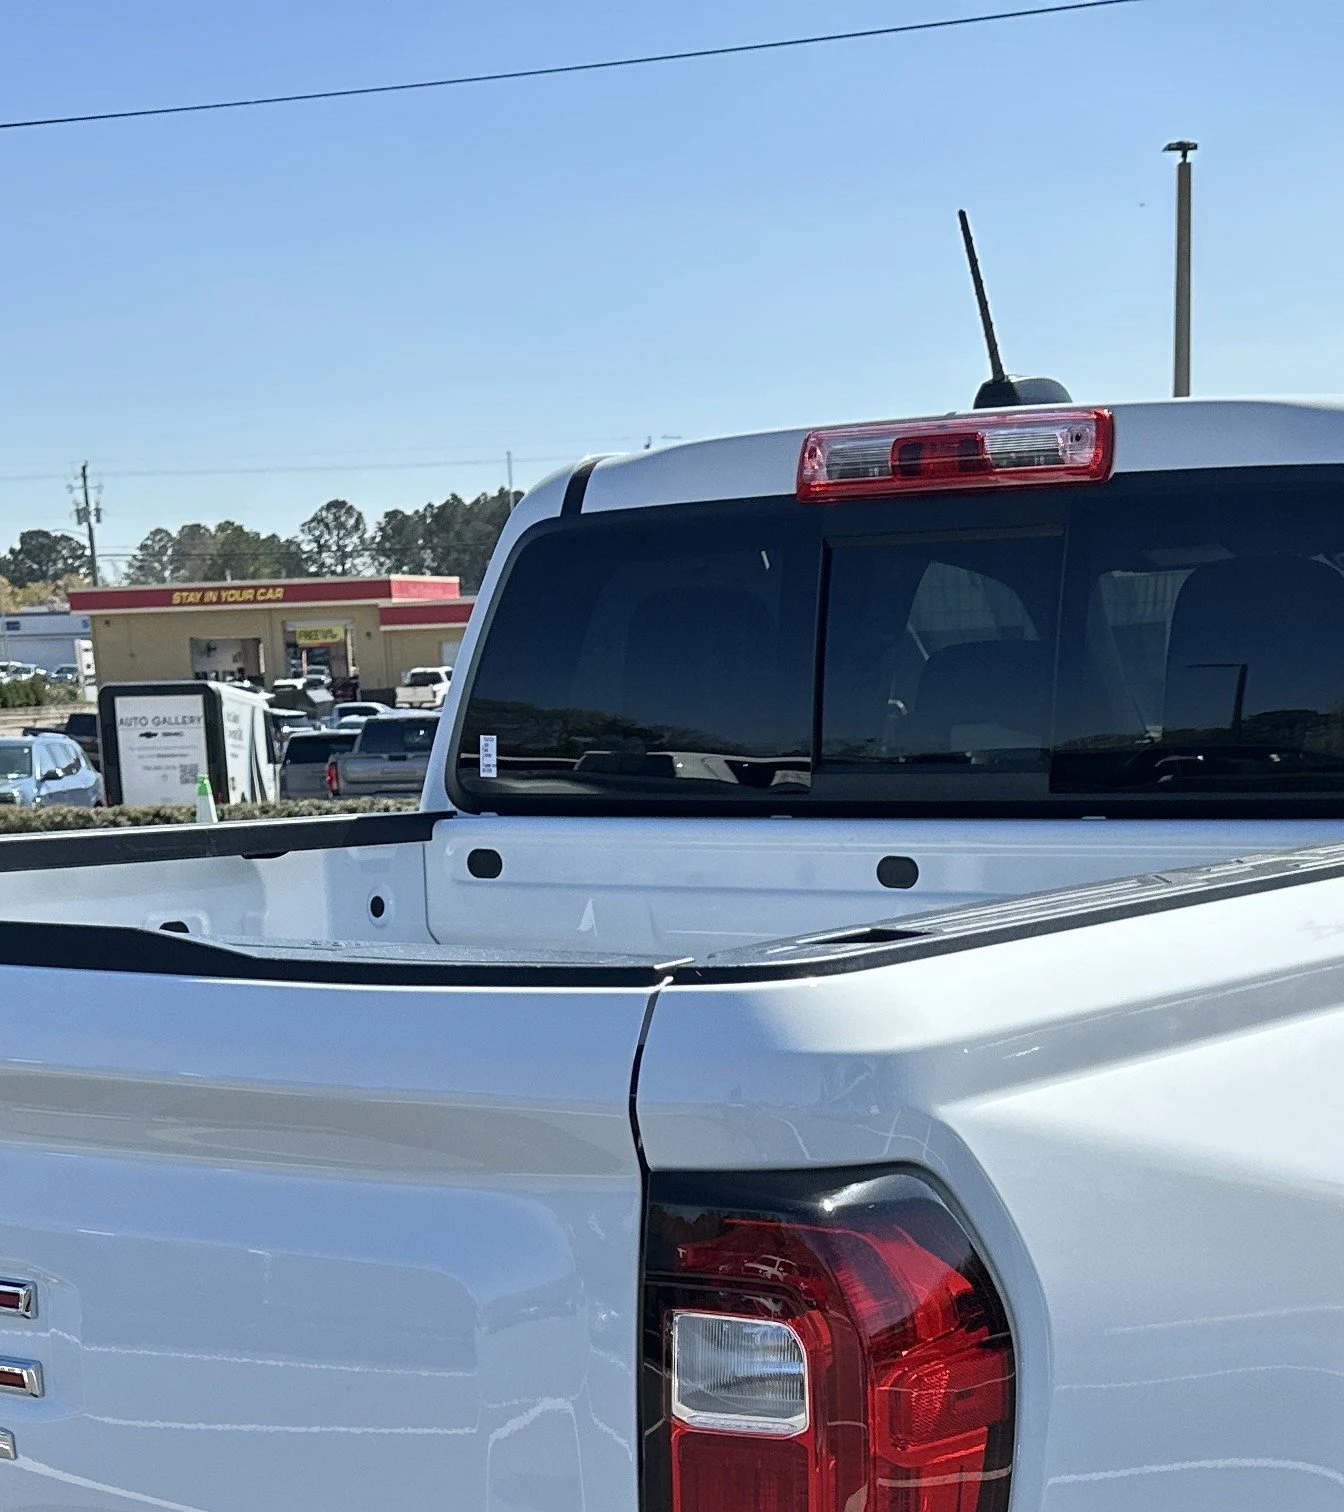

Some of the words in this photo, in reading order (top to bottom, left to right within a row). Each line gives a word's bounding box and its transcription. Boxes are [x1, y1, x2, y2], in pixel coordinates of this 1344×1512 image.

[172, 591, 202, 604] STAY
[204, 591, 218, 603] IN
[221, 589, 256, 602] YOUR
[257, 588, 285, 601] CAR
[119, 715, 149, 727] AUTO
[151, 714, 204, 727] GALLERY
